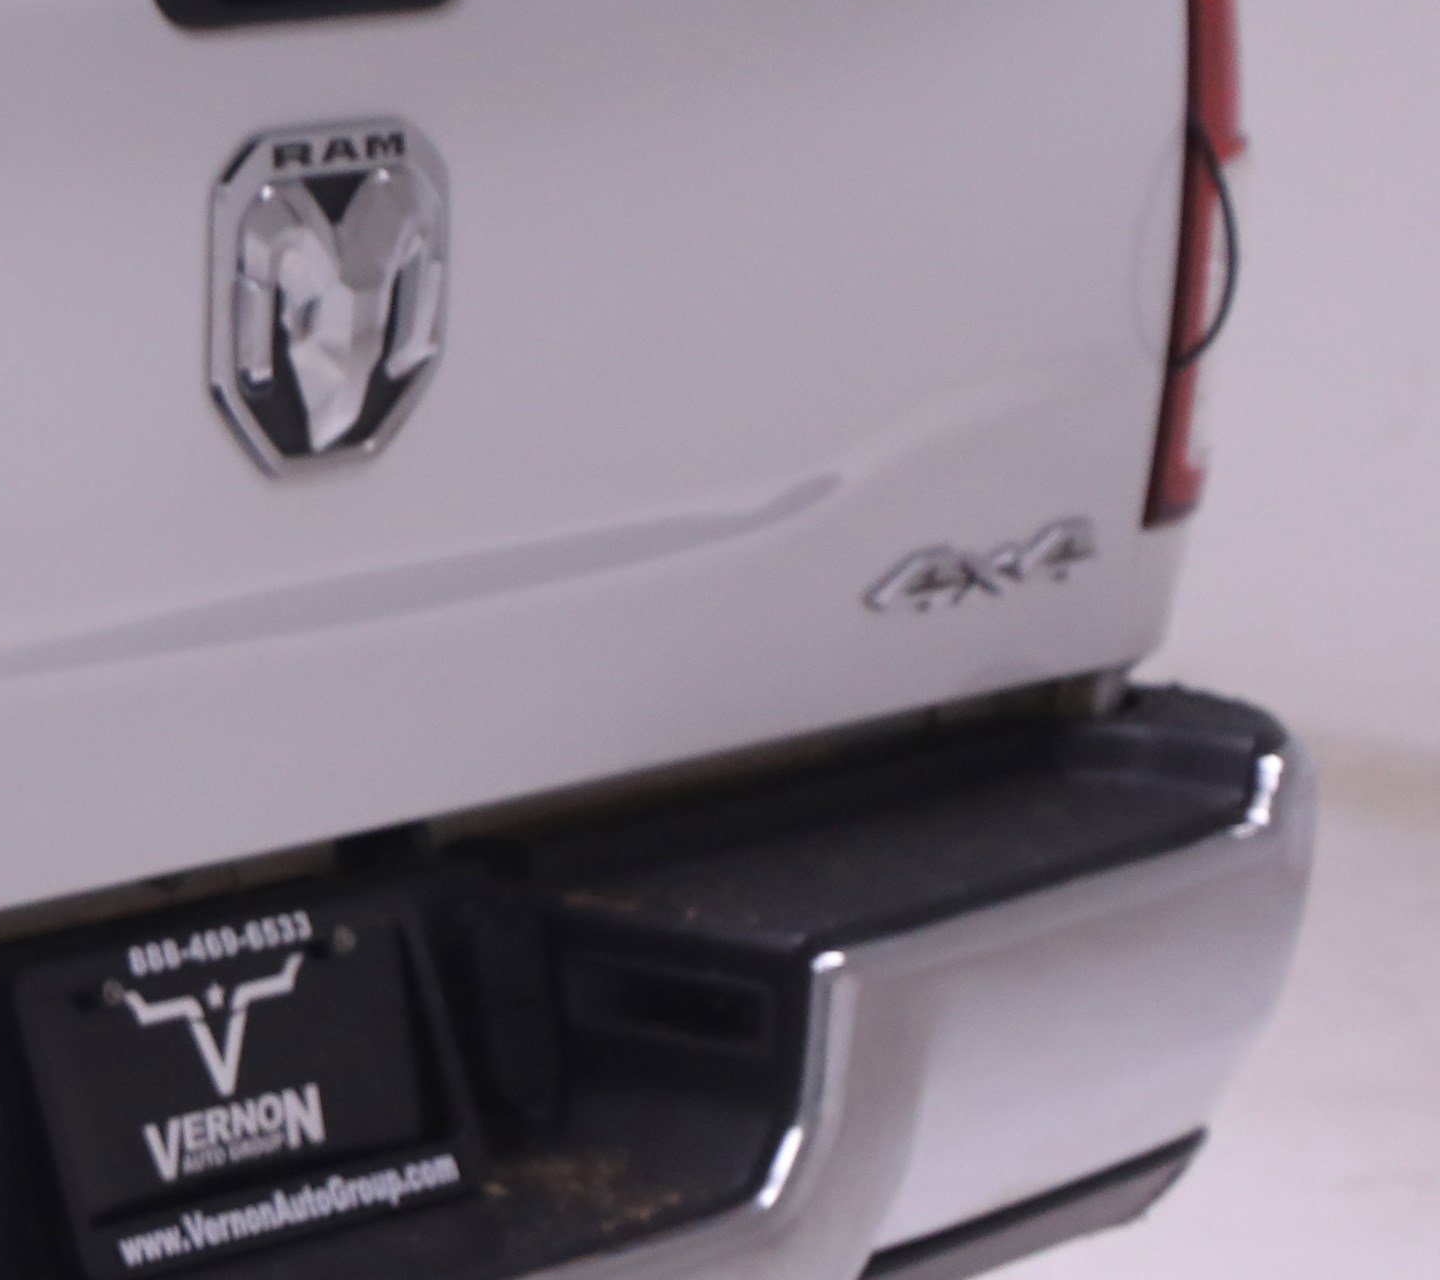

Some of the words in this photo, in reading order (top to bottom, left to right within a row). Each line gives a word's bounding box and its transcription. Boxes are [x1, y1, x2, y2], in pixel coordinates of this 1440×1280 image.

[272, 131, 407, 170] RAM
[142, 1082, 326, 1183] VERNON
[118, 1152, 462, 1267] www.VernonAutoGroup.com
